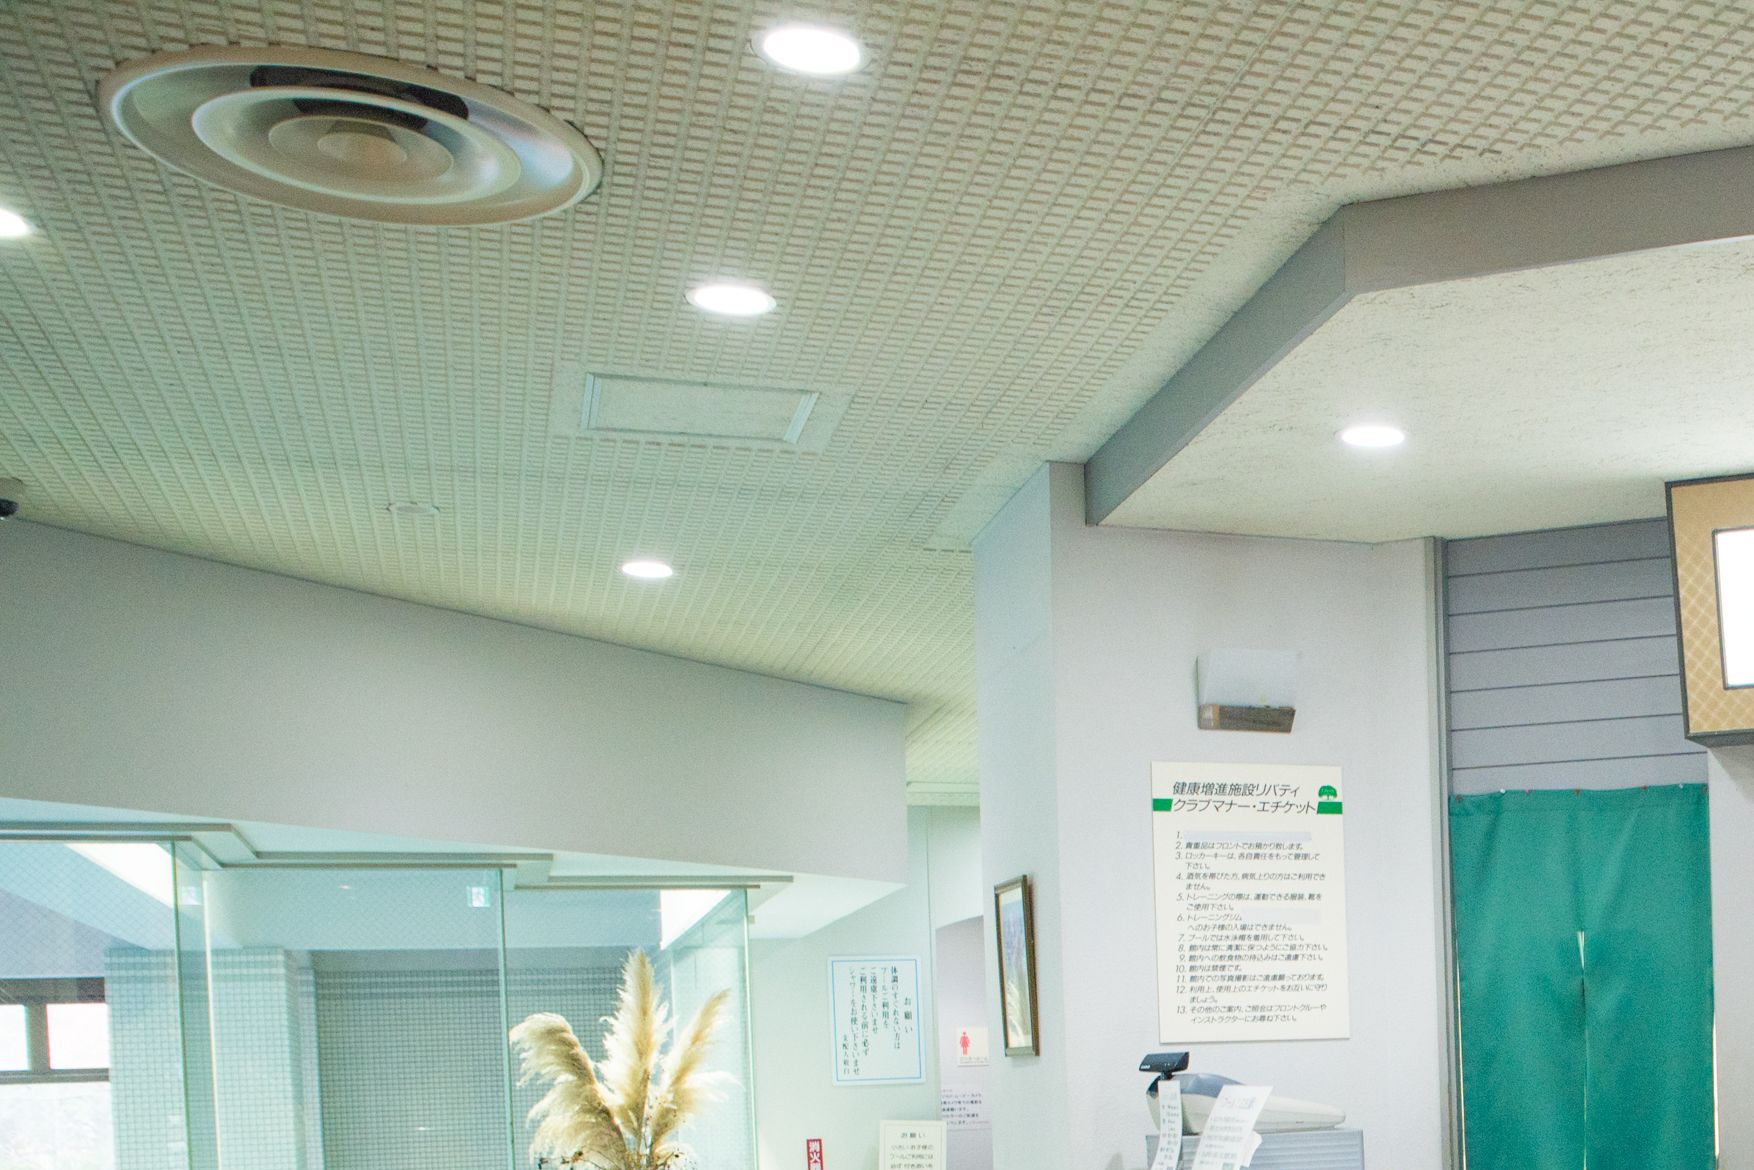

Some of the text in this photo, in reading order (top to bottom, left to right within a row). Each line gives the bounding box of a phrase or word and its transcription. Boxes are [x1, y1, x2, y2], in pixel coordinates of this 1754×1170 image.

[1173, 781, 1301, 798] 健康増進施設リバティ
[1173, 799, 1316, 815] クラブマナー・エチケット
[1176, 831, 1183, 839] 1.
[1175, 842, 1183, 850] 2.
[1175, 852, 1182, 860] 3.
[1177, 893, 1184, 901] 5.
[1178, 944, 1185, 952] 8.
[1179, 954, 1186, 962] 9.
[1176, 975, 1186, 983] 11.
[1176, 986, 1187, 994] 12.
[1176, 1006, 1187, 1014] 13.
[904, 996, 913, 1033] お願い
